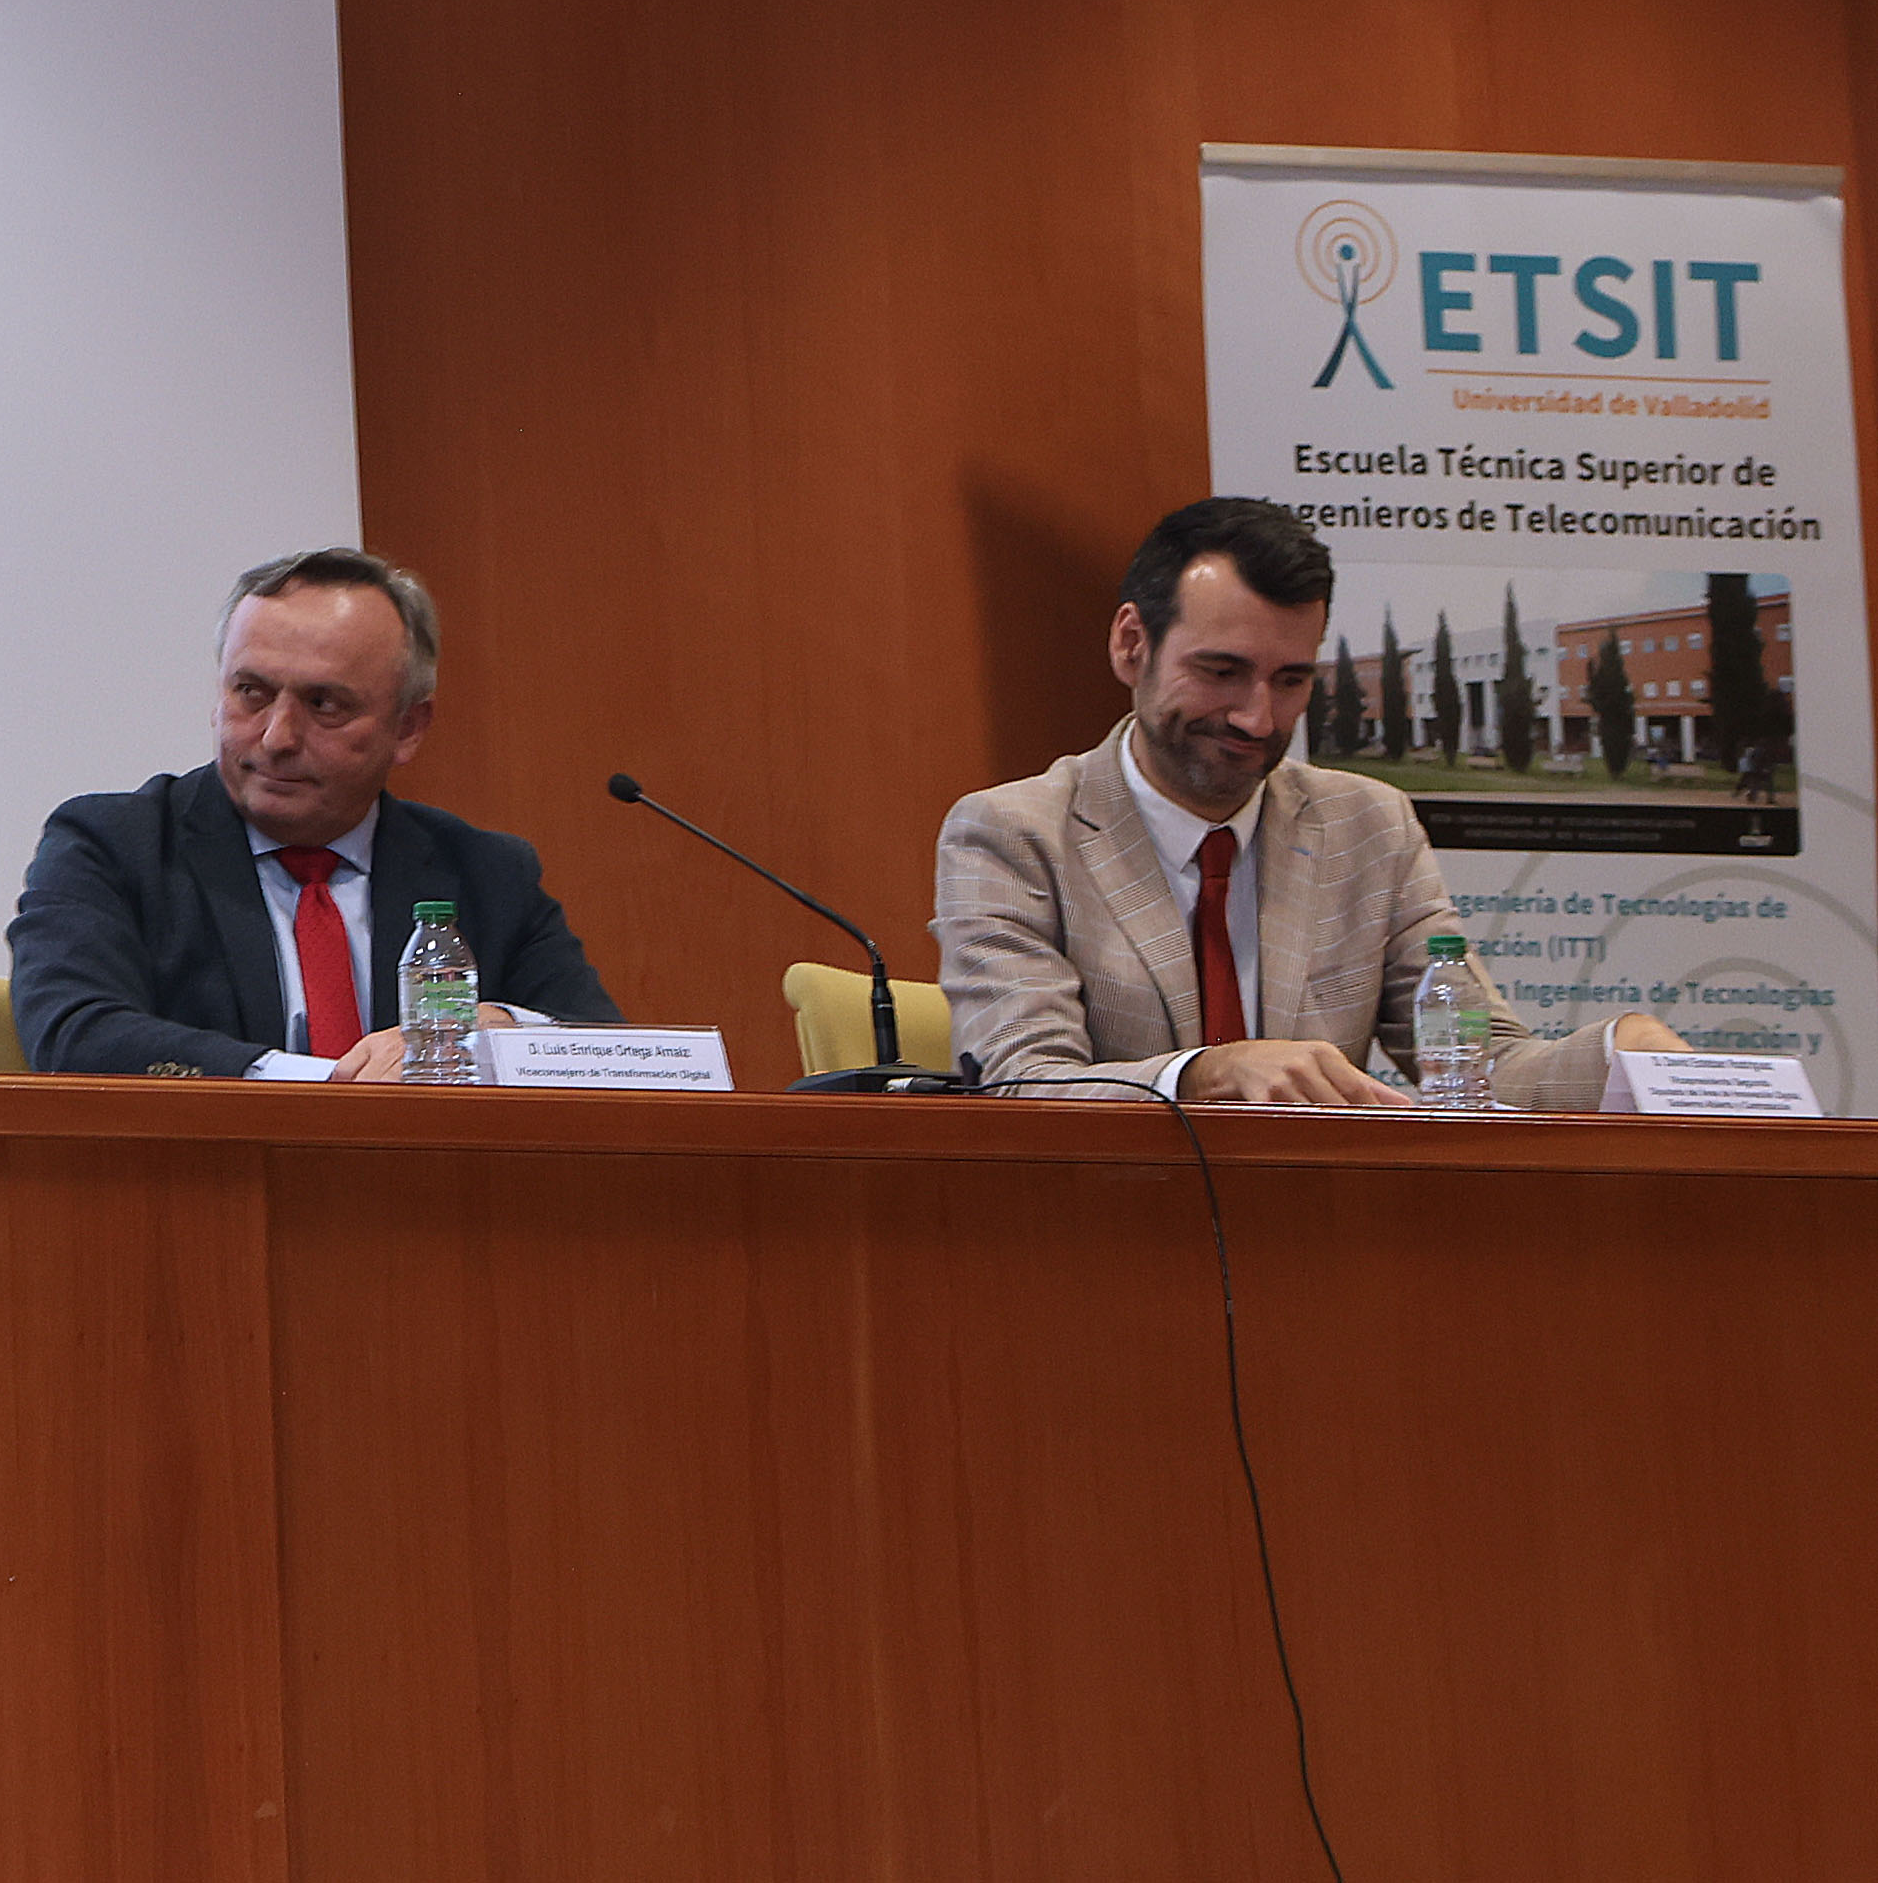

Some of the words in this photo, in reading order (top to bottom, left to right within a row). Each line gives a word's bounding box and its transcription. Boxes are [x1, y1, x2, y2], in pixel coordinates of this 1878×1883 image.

[1419, 251, 1760, 361] ETSIT
[1452, 388, 1604, 415] Universidad
[1610, 393, 1637, 416] de
[1643, 393, 1771, 419] Valladolid
[1295, 444, 1428, 477] Escuela
[1438, 444, 1566, 481] Técnica
[1576, 452, 1722, 490] Superior
[1734, 455, 1776, 487] de
[1281, 496, 1449, 531] genieros
[1457, 500, 1496, 532] de
[1504, 503, 1821, 541] Telecomunicación
[1563, 891, 1594, 915] de
[1600, 892, 1751, 923] Tecnologías
[1756, 895, 1787, 919] de
[1514, 978, 1642, 1008] Ingeniería
[1649, 980, 1681, 1004] de
[1685, 980, 1835, 1011] Tecnologías
[544, 1043, 567, 1056] Luis
[571, 1043, 613, 1059] Enrique
[1806, 1033, 1823, 1055] y
[587, 1068, 601, 1078] de
